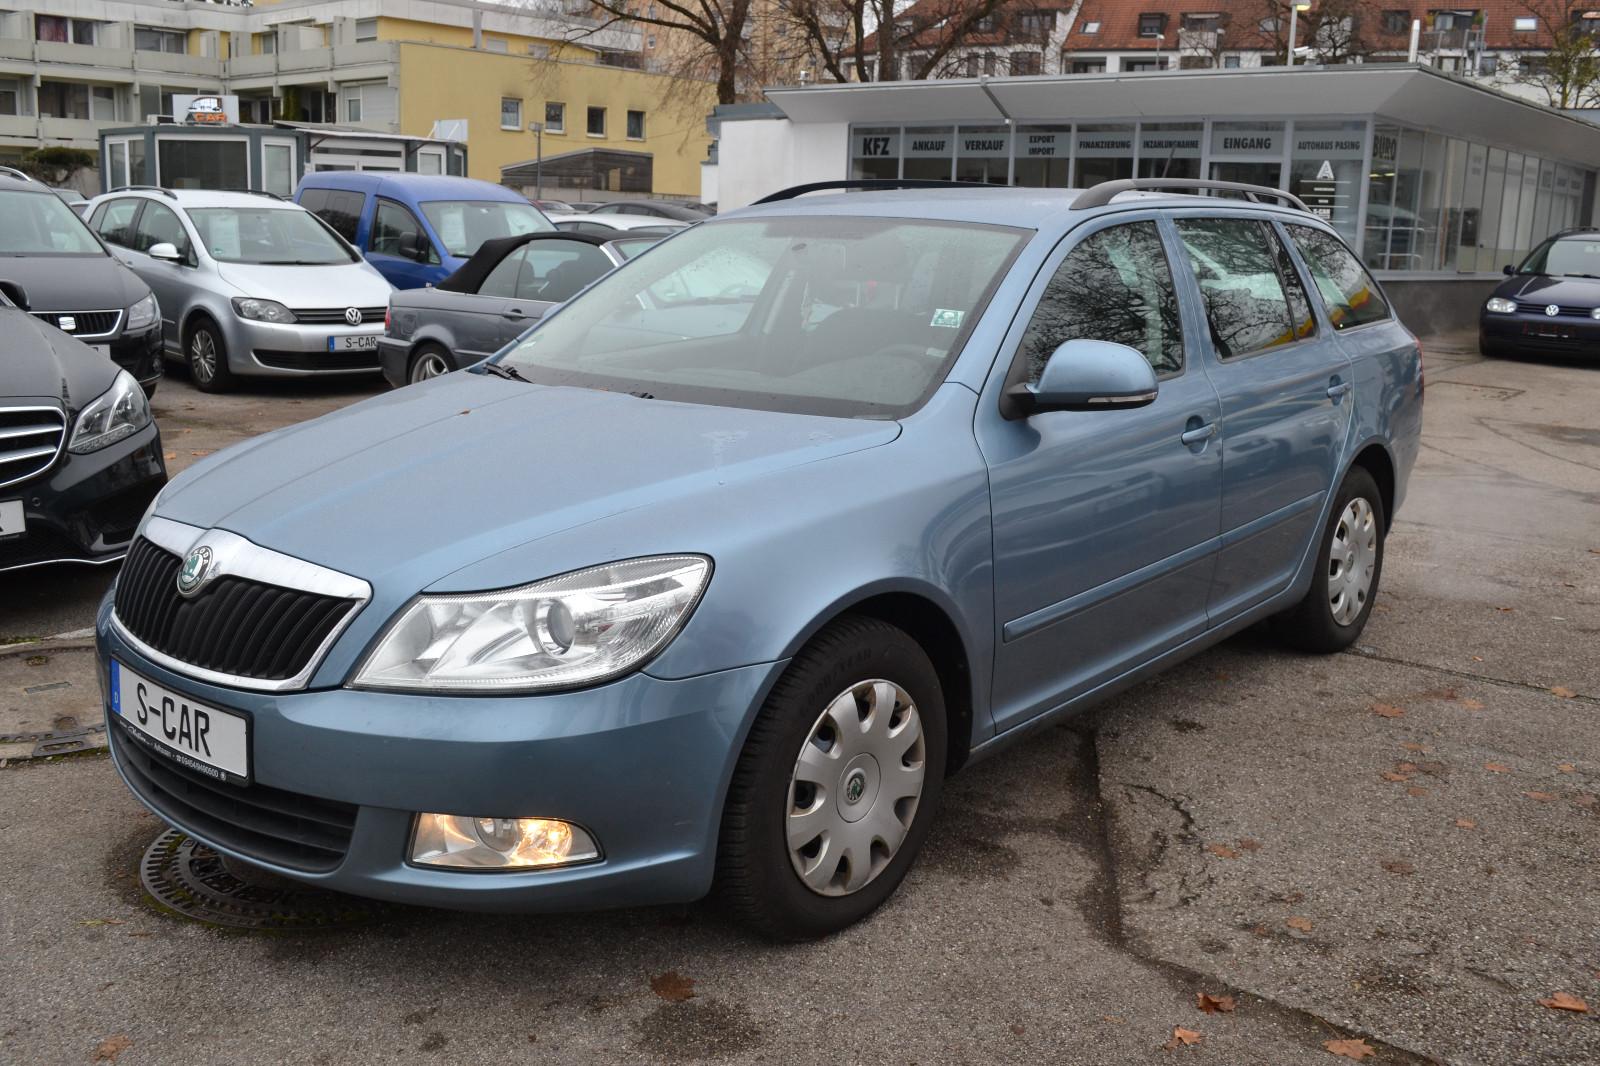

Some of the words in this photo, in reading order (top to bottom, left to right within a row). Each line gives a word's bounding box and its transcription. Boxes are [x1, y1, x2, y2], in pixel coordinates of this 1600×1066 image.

[1029, 135, 1055, 143] EXPORT
[1079, 140, 1132, 149] FINANZIERUNG
[1223, 137, 1272, 150] EINGANG
[862, 137, 890, 156] KFZ
[912, 140, 946, 151] ANKAUF
[964, 139, 1005, 151] VERKAUF
[1298, 141, 1334, 150] AUTOHAUS
[1335, 141, 1360, 150] PASING
[1028, 147, 1055, 155] IMPORT
[345, 336, 377, 348] S-CAR
[136, 682, 211, 757] S-CAR
